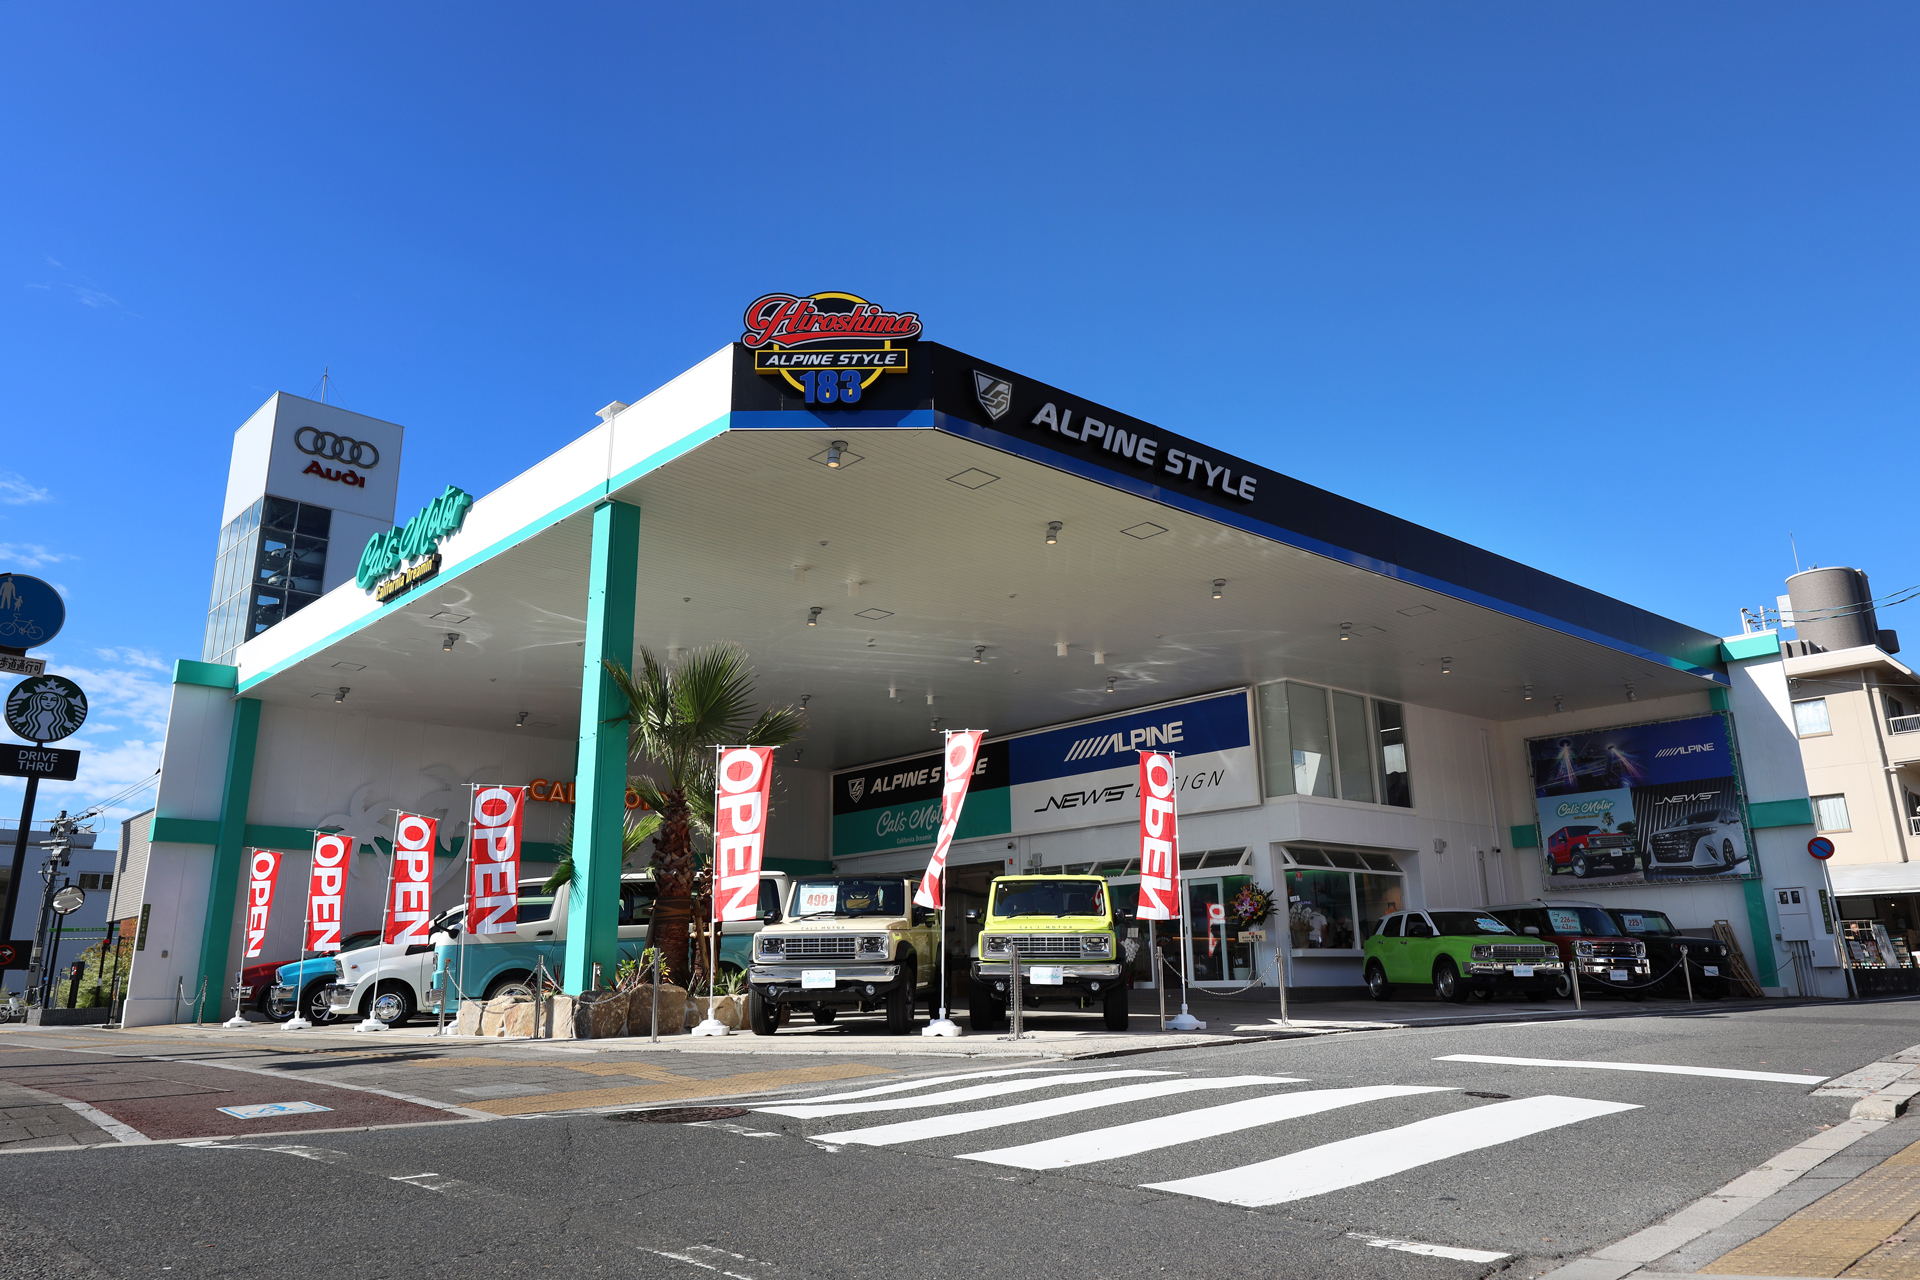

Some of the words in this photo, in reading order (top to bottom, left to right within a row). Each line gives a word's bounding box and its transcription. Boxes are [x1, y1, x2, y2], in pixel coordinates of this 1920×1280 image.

[743, 295, 921, 347] Hiroshima
[765, 354, 834, 366] ALPINE
[837, 353, 899, 365] STYLE
[800, 369, 862, 404] 183
[1031, 402, 1158, 466] ALPINE
[1164, 448, 1257, 501] STYLE
[302, 460, 366, 488] Audi
[356, 526, 401, 589] Cal's
[399, 485, 467, 560] Motor
[1098, 720, 1184, 756] ALPINE
[1673, 742, 1715, 756] ALPINE
[17, 760, 55, 772] THRU
[18, 750, 59, 763] DRIVE
[870, 768, 929, 795] ALPINE
[876, 810, 907, 837] Cal's
[1557, 803, 1580, 816] Cal's
[1581, 799, 1614, 813] Motor
[719, 749, 763, 921] OPEN
[896, 836, 915, 844] California
[473, 788, 517, 934] OPEN
[311, 835, 345, 951] OPEN
[394, 816, 431, 945] OPEN
[247, 851, 275, 958] OPEN
